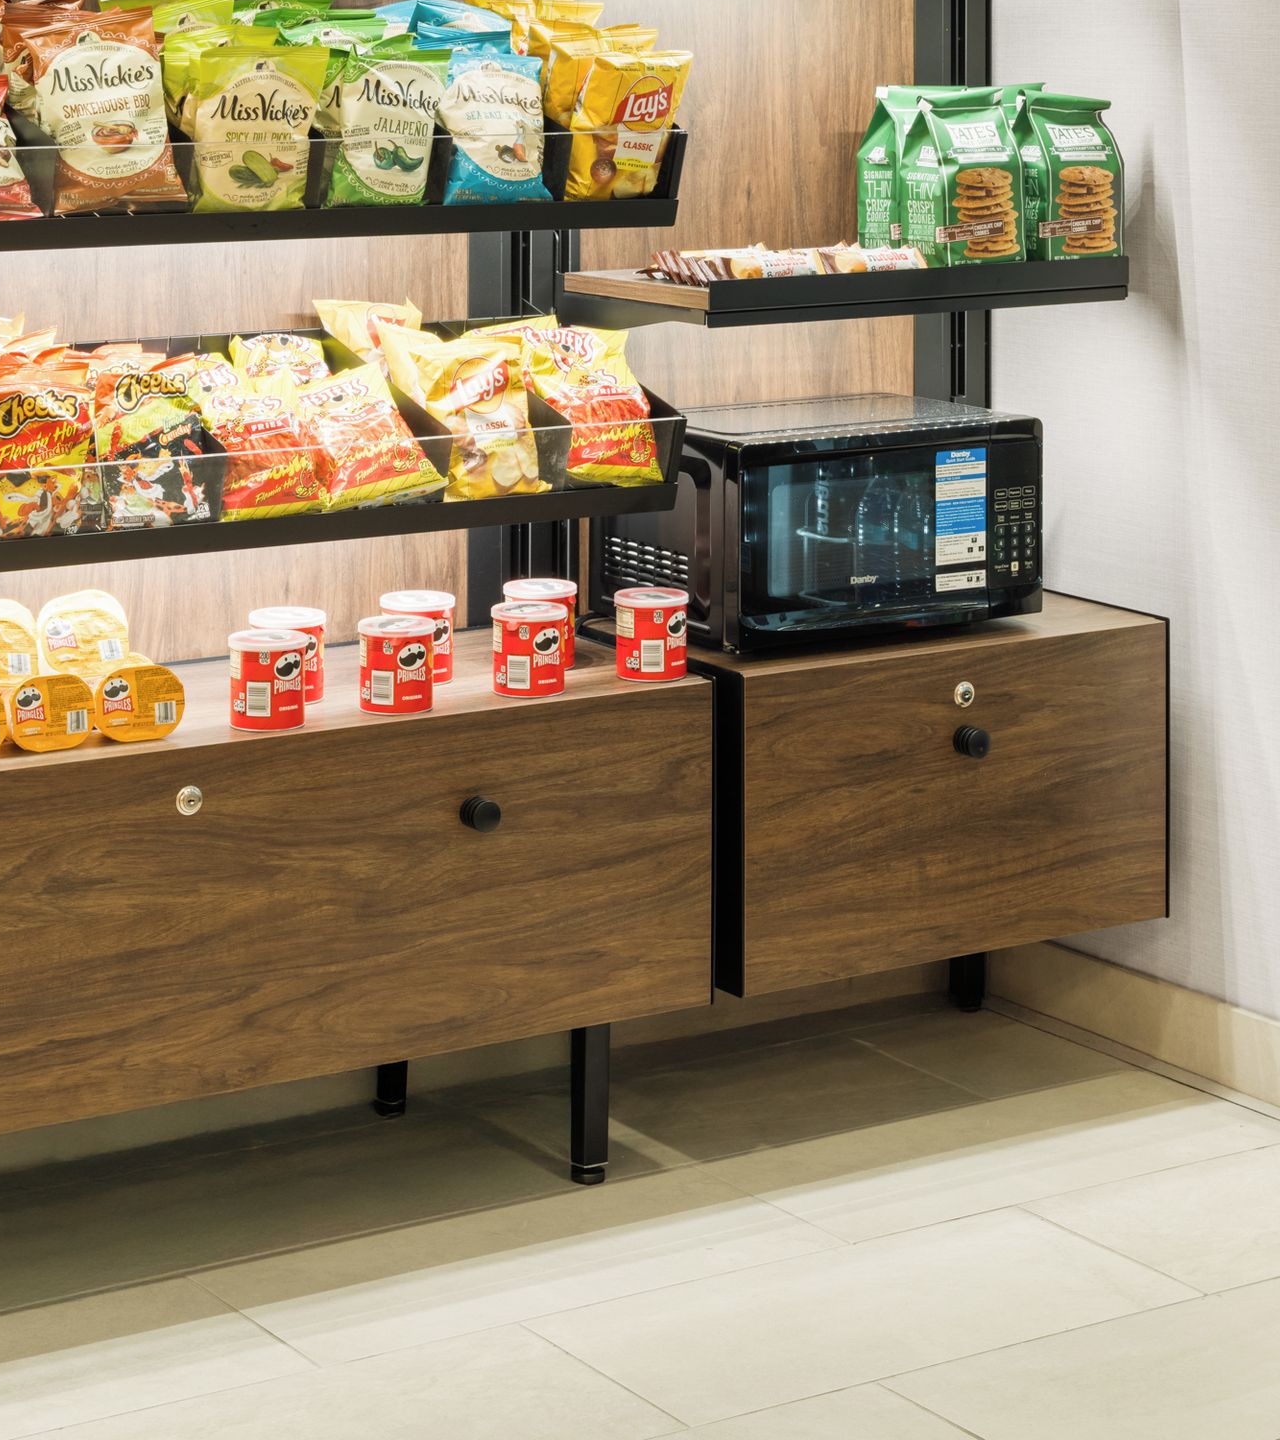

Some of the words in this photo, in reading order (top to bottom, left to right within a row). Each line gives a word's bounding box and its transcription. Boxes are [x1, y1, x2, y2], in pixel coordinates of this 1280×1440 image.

[62, 99, 131, 118] SMOKEHOUSE
[622, 86, 671, 122] Lay's
[951, 124, 997, 141] TATE'S
[1048, 125, 1096, 140] TATE'S
[623, 139, 654, 152] CLASSIC
[864, 170, 893, 180] SIGNATURE
[864, 181, 892, 198] THIN
[906, 180, 936, 199] THIN
[865, 199, 891, 212] CRISPY
[907, 200, 935, 213] CRISPY
[866, 211, 890, 223] COOKIES
[908, 212, 936, 225] COOKIES
[115, 370, 187, 413] Cheetos
[475, 419, 509, 433] CLASSIC
[850, 574, 878, 586] Danby
[533, 653, 561, 669] PRINGLES
[397, 667, 426, 684] PRINGLES
[103, 697, 132, 712] PRINGLES
